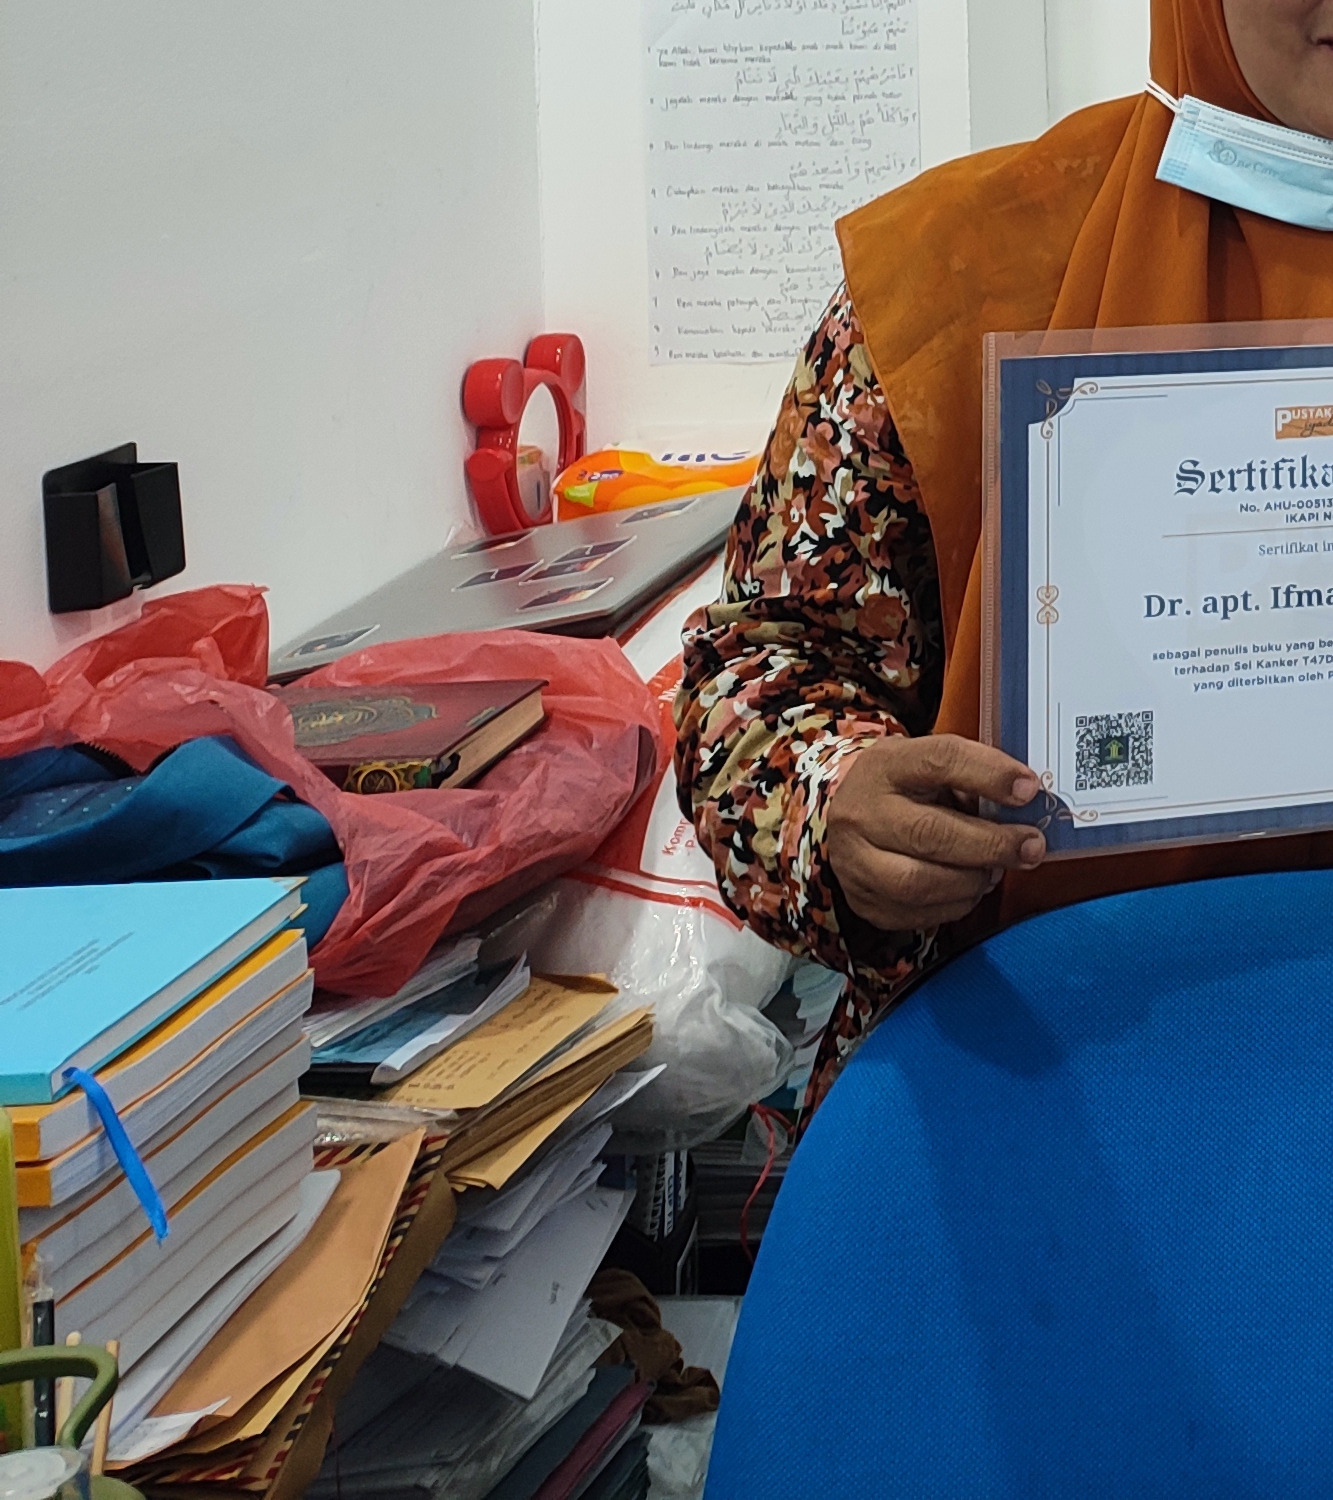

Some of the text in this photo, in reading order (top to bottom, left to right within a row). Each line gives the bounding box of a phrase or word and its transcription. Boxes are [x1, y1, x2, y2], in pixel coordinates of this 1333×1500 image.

[1239, 503, 1260, 513] No.
[1285, 513, 1320, 524] IKAPI
[1258, 540, 1319, 556] Sertifikat
[1143, 592, 1192, 619] Dr.
[1202, 588, 1261, 622] apt.
[1152, 648, 1201, 661] sebagai
[1204, 645, 1248, 659] penulis
[1252, 642, 1282, 654] buku
[1286, 640, 1315, 653] yang
[1174, 664, 1230, 676] terhadap
[1234, 661, 1252, 671] Sel
[1256, 658, 1298, 669] Kanker
[1193, 680, 1224, 693] yang
[1227, 673, 1295, 688] diterbitkan
[1298, 670, 1324, 682] oleh
